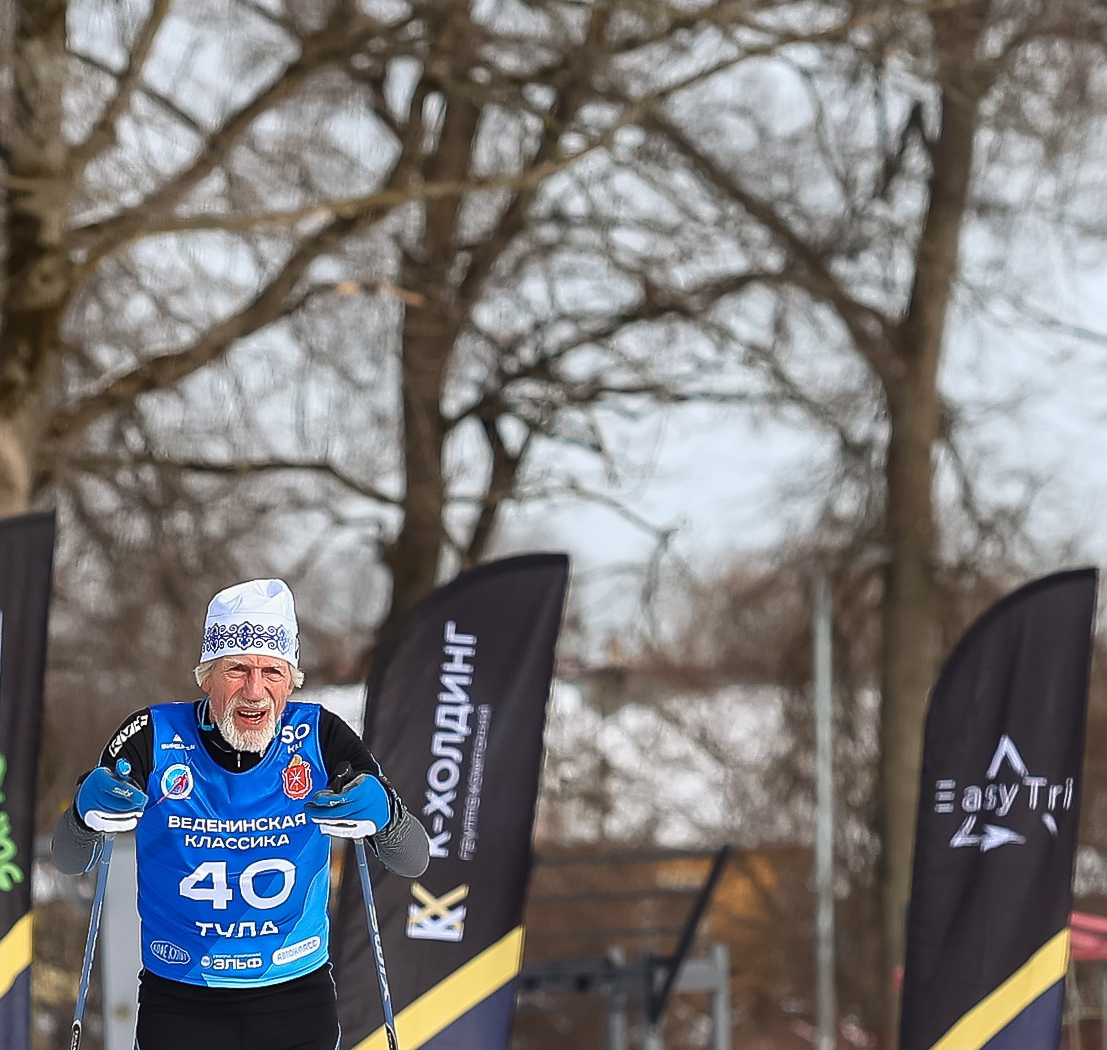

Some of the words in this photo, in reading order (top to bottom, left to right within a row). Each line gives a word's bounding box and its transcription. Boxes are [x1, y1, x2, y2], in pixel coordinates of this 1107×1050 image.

[281, 723, 310, 744] 50
[168, 813, 307, 833] ВЕДЕНИНСКАЯ
[185, 834, 290, 850] КЛАССИКА
[179, 858, 296, 909] 40
[195, 921, 279, 938] ТУЛА
[212, 958, 263, 970] ЭЛЬФ
